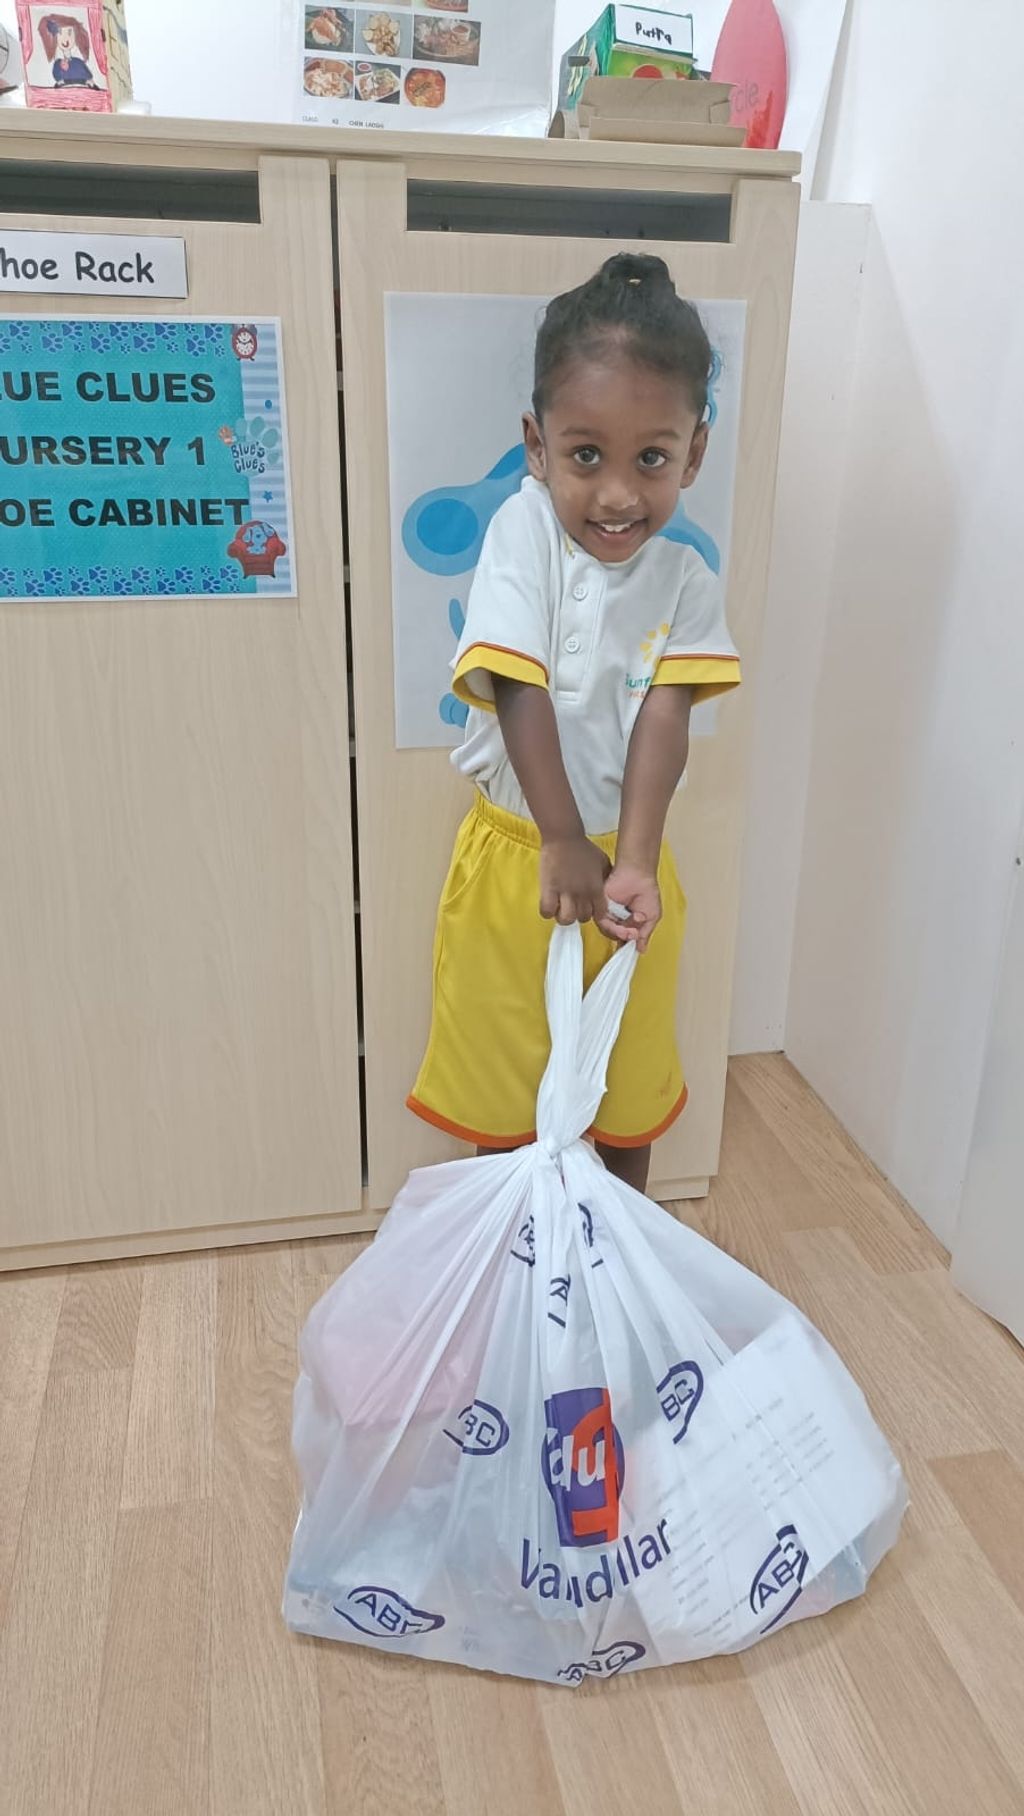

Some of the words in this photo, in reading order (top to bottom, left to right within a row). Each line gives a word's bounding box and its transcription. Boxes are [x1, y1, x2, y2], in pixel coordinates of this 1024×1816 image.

[75, 251, 155, 284] Rack
[0, 371, 62, 402] UE
[76, 371, 216, 403] CLUES
[187, 437, 206, 466] 1
[231, 441, 265, 459] Blue's
[234, 458, 265, 474] Clues
[68, 498, 250, 527] CABINET
[758, 1541, 803, 1609] ABC
